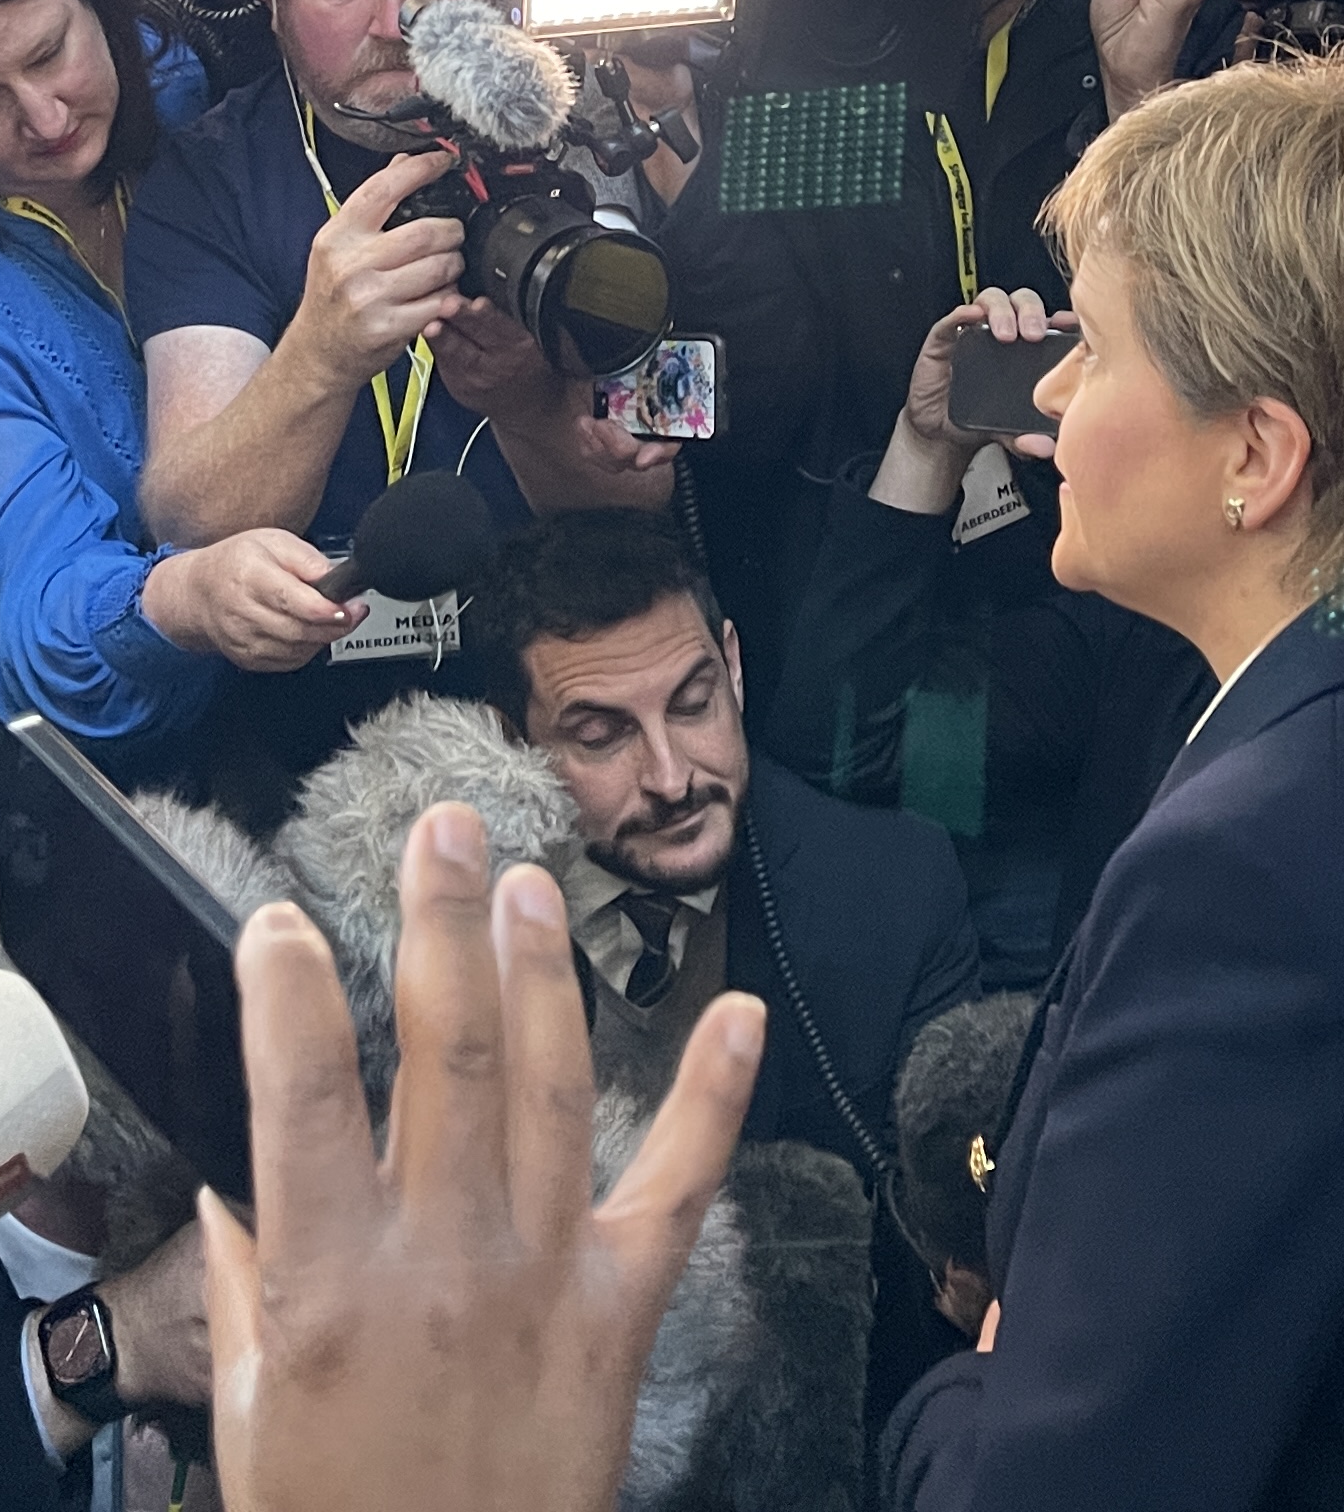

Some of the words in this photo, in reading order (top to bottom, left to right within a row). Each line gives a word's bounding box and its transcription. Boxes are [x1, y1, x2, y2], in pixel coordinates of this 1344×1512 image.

[961, 498, 1022, 533] ABERDEEN
[395, 613, 456, 630] MEDIA
[344, 633, 421, 651] ABERDEEN
